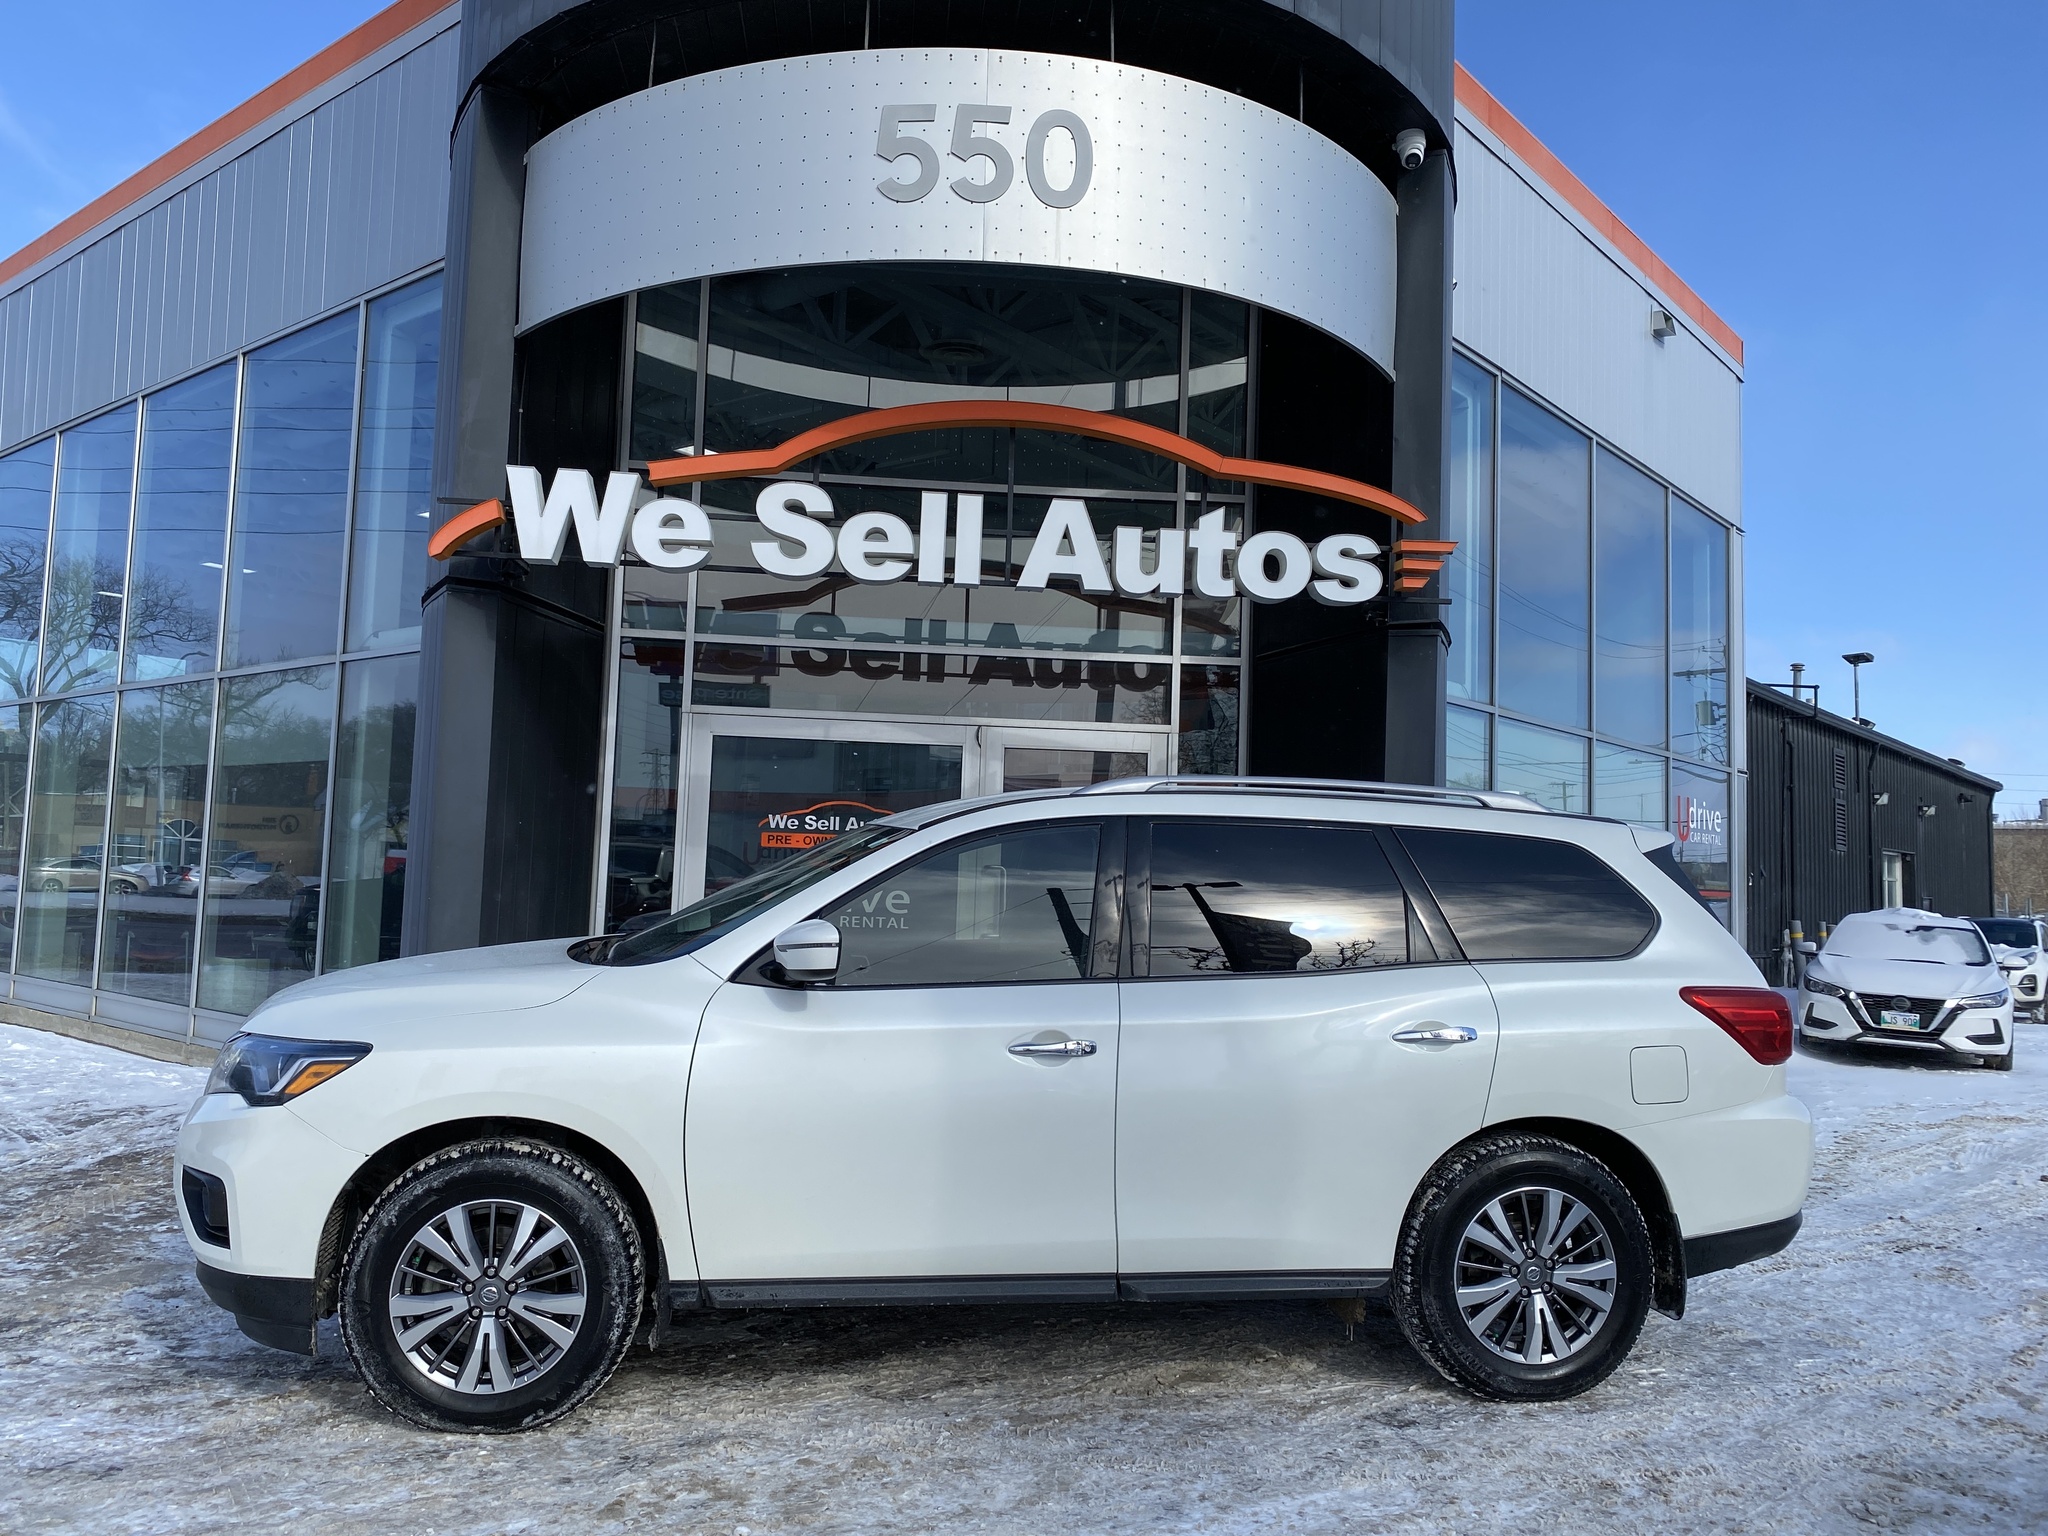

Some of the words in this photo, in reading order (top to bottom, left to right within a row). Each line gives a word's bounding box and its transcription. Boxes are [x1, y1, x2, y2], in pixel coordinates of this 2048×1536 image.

[876, 103, 1094, 209] 550
[506, 464, 714, 575] We
[750, 481, 984, 589] Sell
[1015, 498, 1383, 606] Autos
[768, 814, 799, 829] We
[804, 815, 840, 831] Sell
[767, 834, 792, 845] PRE
[1690, 831, 1702, 844] CAR
[1702, 832, 1722, 846] RENTAL
[839, 915, 909, 929] RENTAL
